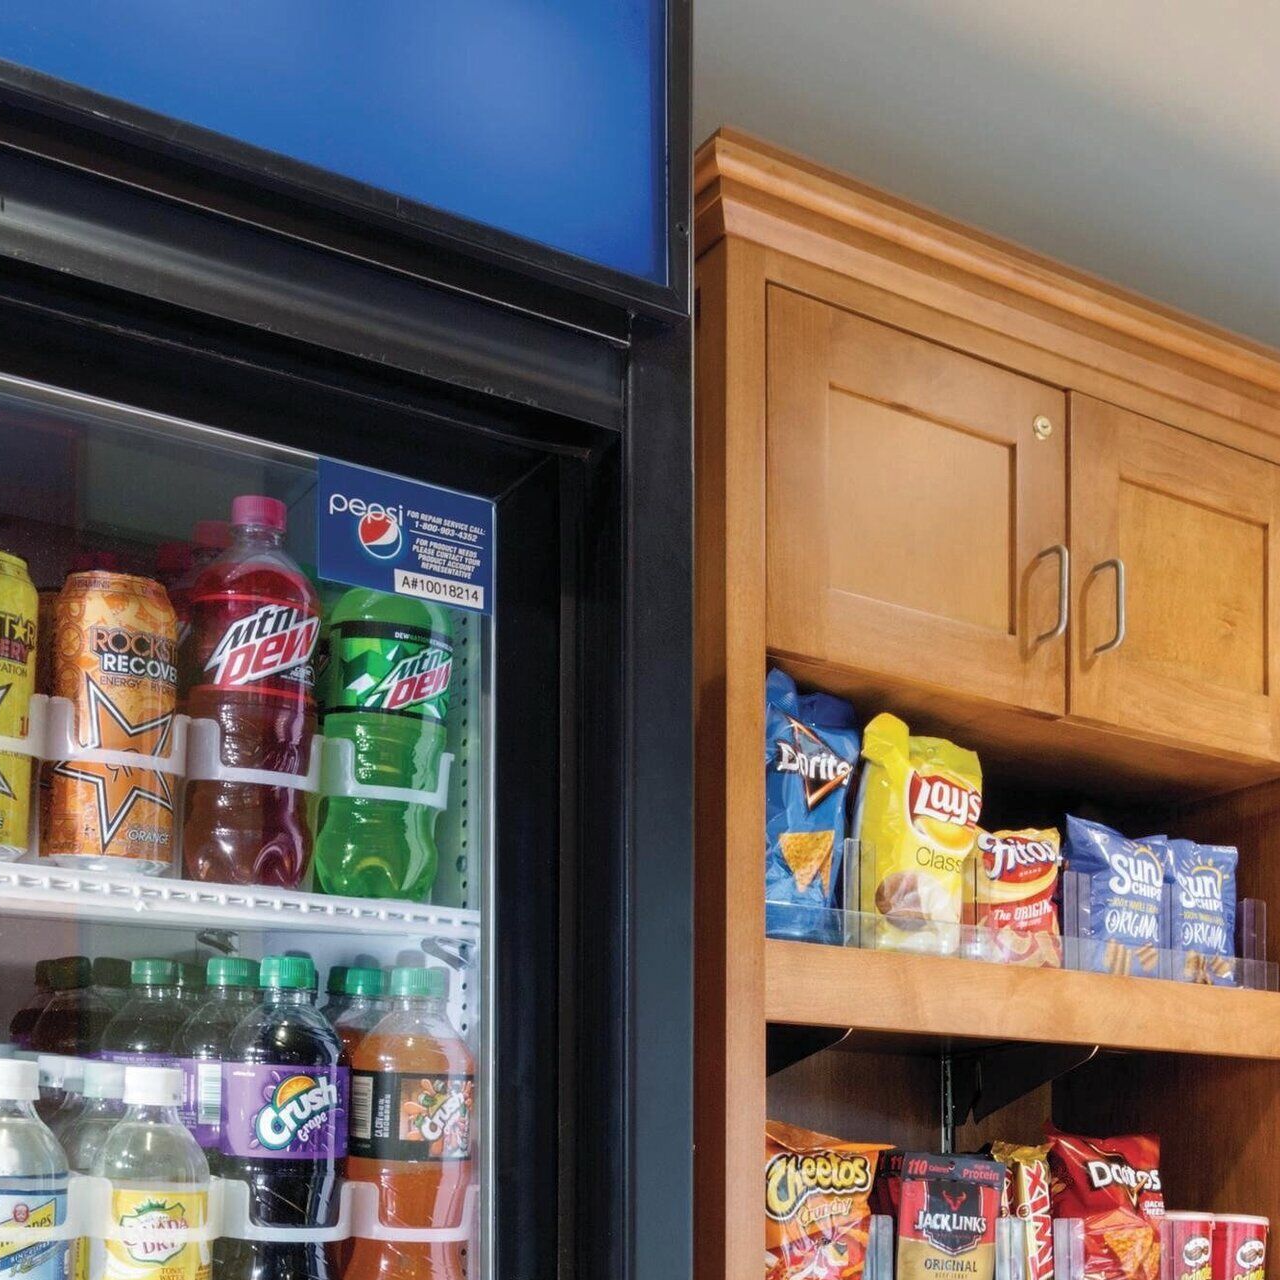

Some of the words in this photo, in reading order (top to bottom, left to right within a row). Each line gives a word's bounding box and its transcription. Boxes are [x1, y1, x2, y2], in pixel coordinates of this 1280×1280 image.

[329, 494, 403, 526] pepsi
[407, 510, 420, 520] FOR
[421, 513, 443, 525] REPAIR
[444, 517, 468, 531] SERVICE
[412, 546, 435, 557] PLEASE
[437, 549, 463, 562] CONTACT
[464, 556, 480, 566] YOUR
[416, 538, 429, 547] FOR
[429, 540, 457, 554] PRODUCT
[418, 554, 446, 568] PRODUCT
[447, 560, 475, 572] ACCOUNT
[421, 562, 471, 579] REPRESENTATIVE
[402, 576, 479, 602] A#10018214
[913, 776, 983, 828] Lay's
[126, 825, 170, 845] ORANGE
[977, 832, 1064, 880] Fritos
[1109, 853, 1163, 895] Sun
[1177, 872, 1222, 909] Sun
[257, 1076, 340, 1147] Crush
[297, 1110, 328, 1143] Grape
[907, 1159, 927, 1175] 110
[962, 1167, 1000, 1182] Protein
[1087, 1160, 1163, 1192] Doritos
[765, 1151, 872, 1221] Cheetos
[915, 1210, 952, 1233] JACK
[924, 1258, 978, 1274] ORIGINAL
